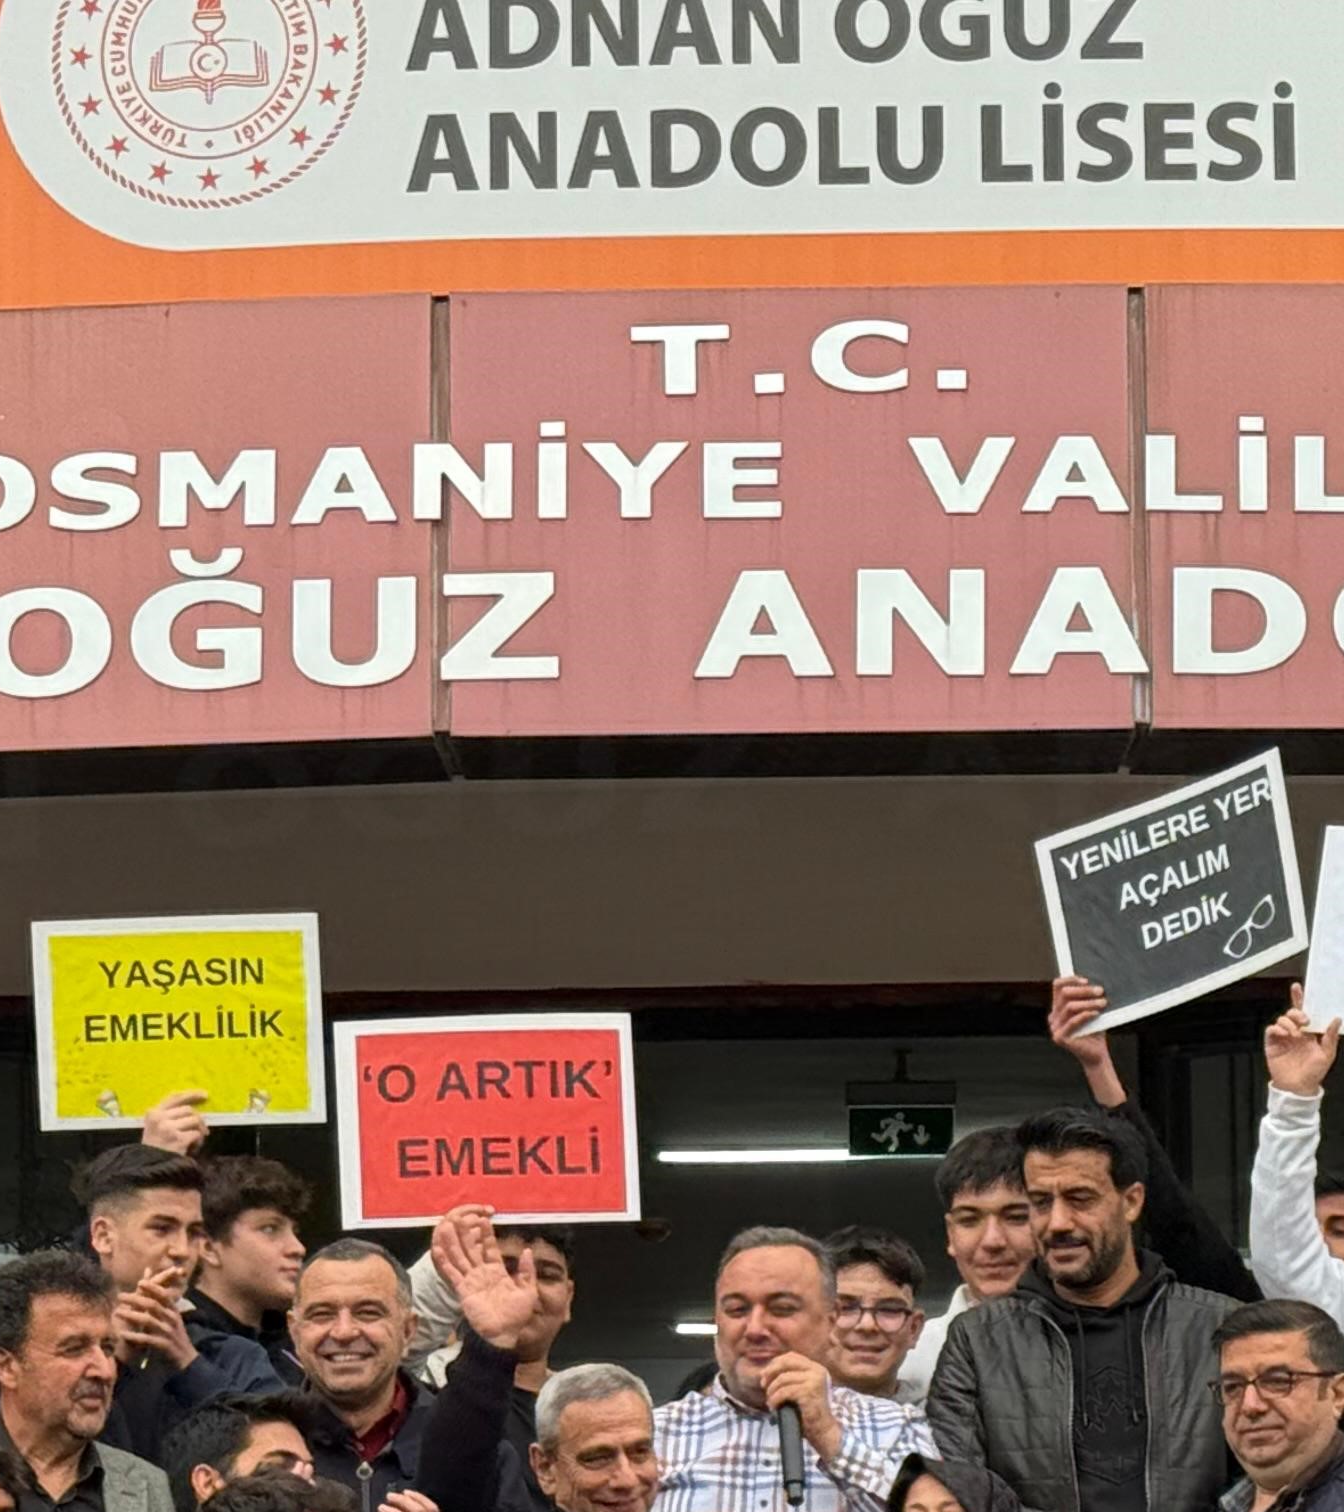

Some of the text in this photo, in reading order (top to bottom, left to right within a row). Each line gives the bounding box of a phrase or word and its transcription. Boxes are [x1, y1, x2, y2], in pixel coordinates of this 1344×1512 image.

[405, 0, 800, 71] ADNAN
[406, 81, 1296, 192] ANADOLU LİSESİ
[1059, 777, 1273, 881] YENİLERE YER
[1119, 844, 1231, 911] AÇALIM
[1141, 892, 1233, 950] DEDİK
[98, 957, 265, 995] YAŞASIN
[84, 1003, 284, 1044] EMEKLİLİK
[398, 1126, 601, 1179] EMEKLİ
